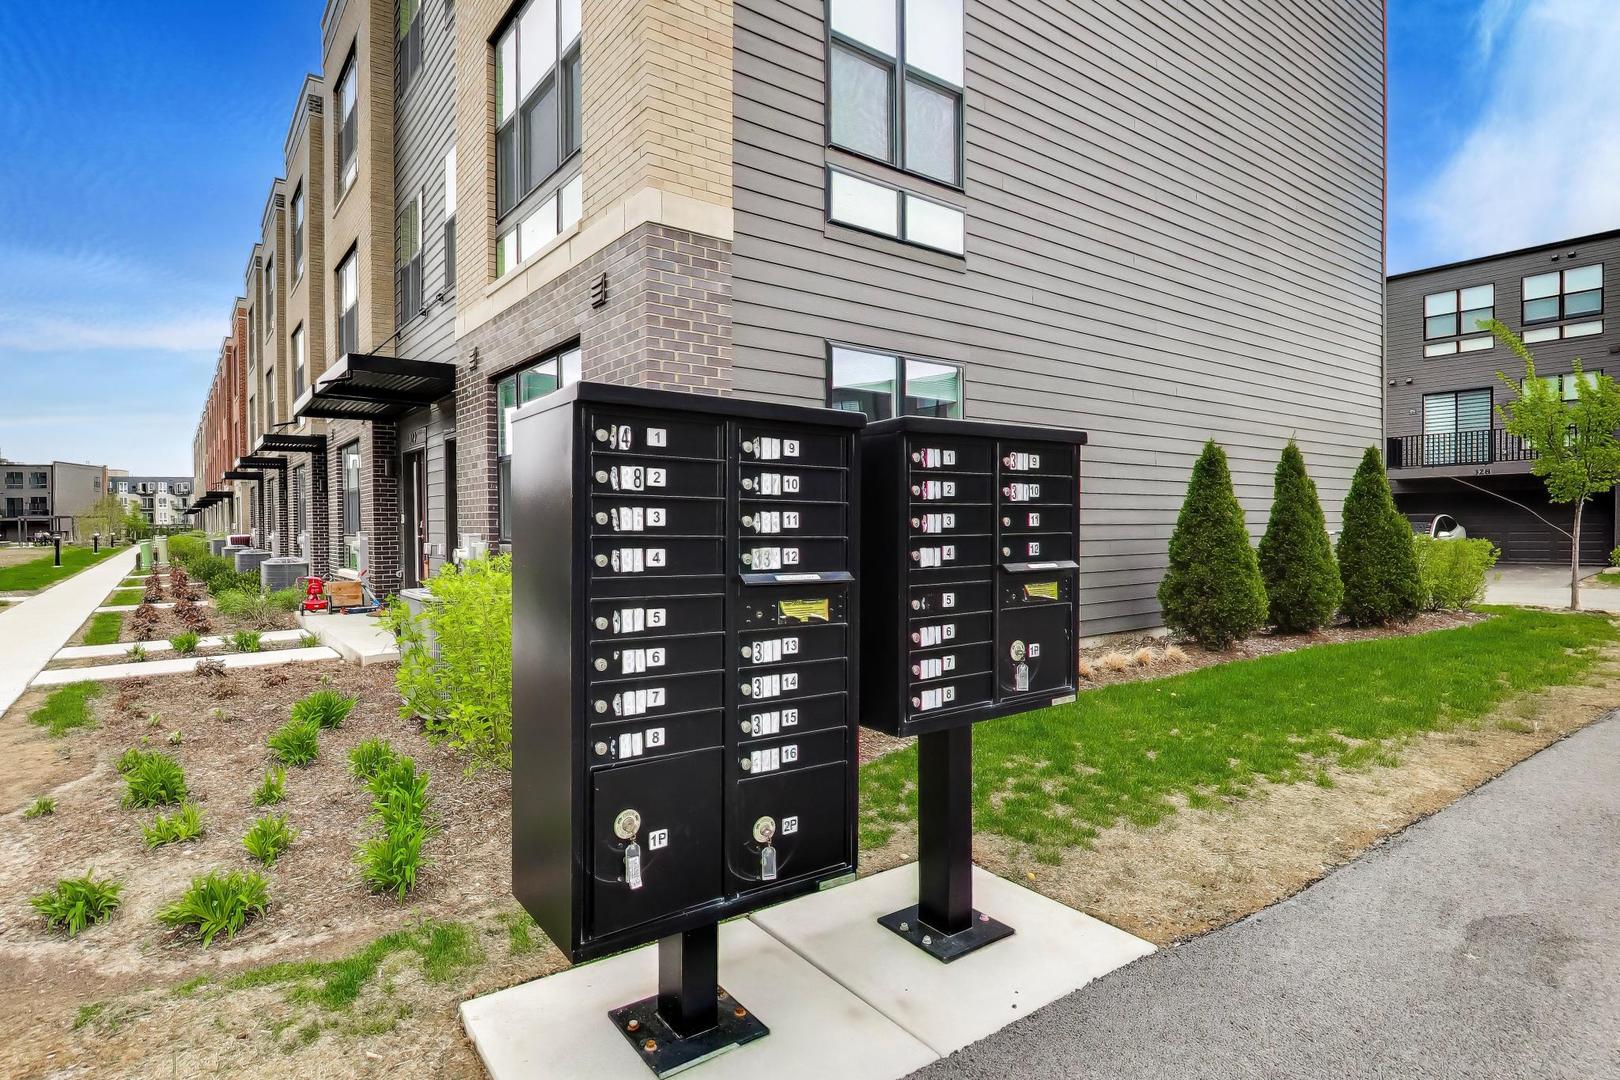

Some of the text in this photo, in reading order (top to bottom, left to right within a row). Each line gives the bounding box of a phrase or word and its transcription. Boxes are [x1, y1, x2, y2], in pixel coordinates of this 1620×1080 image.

[621, 427, 630, 449] 4
[654, 431, 661, 444] 1
[788, 442, 795, 454] 9
[947, 453, 952, 463] 1
[1032, 456, 1037, 466] 9
[633, 468, 642, 489] 8
[653, 471, 661, 484] 2
[785, 478, 798, 490] 10
[946, 484, 952, 495] 2
[1030, 485, 1039, 496] 10
[653, 511, 661, 524] 3
[785, 514, 798, 526] 11
[946, 516, 952, 526] 3
[1030, 515, 1039, 525] 11
[945, 547, 952, 558] 4
[1030, 544, 1039, 555] 12
[652, 551, 661, 564] 4
[784, 550, 798, 563] 12
[946, 595, 952, 605] 5
[653, 611, 661, 624] 5
[946, 626, 952, 637] 6
[784, 639, 798, 652] 13
[652, 651, 661, 663] 6
[754, 642, 763, 663] 3
[946, 657, 952, 668] 7
[754, 677, 763, 698] 3
[784, 675, 797, 688] 14
[652, 691, 661, 704] 7
[946, 689, 952, 700] 8
[783, 711, 797, 724] 15
[753, 715, 762, 735] 3
[651, 731, 660, 744] 8
[783, 747, 797, 760] 16
[783, 819, 797, 833] 2P
[650, 832, 667, 848] 1P
